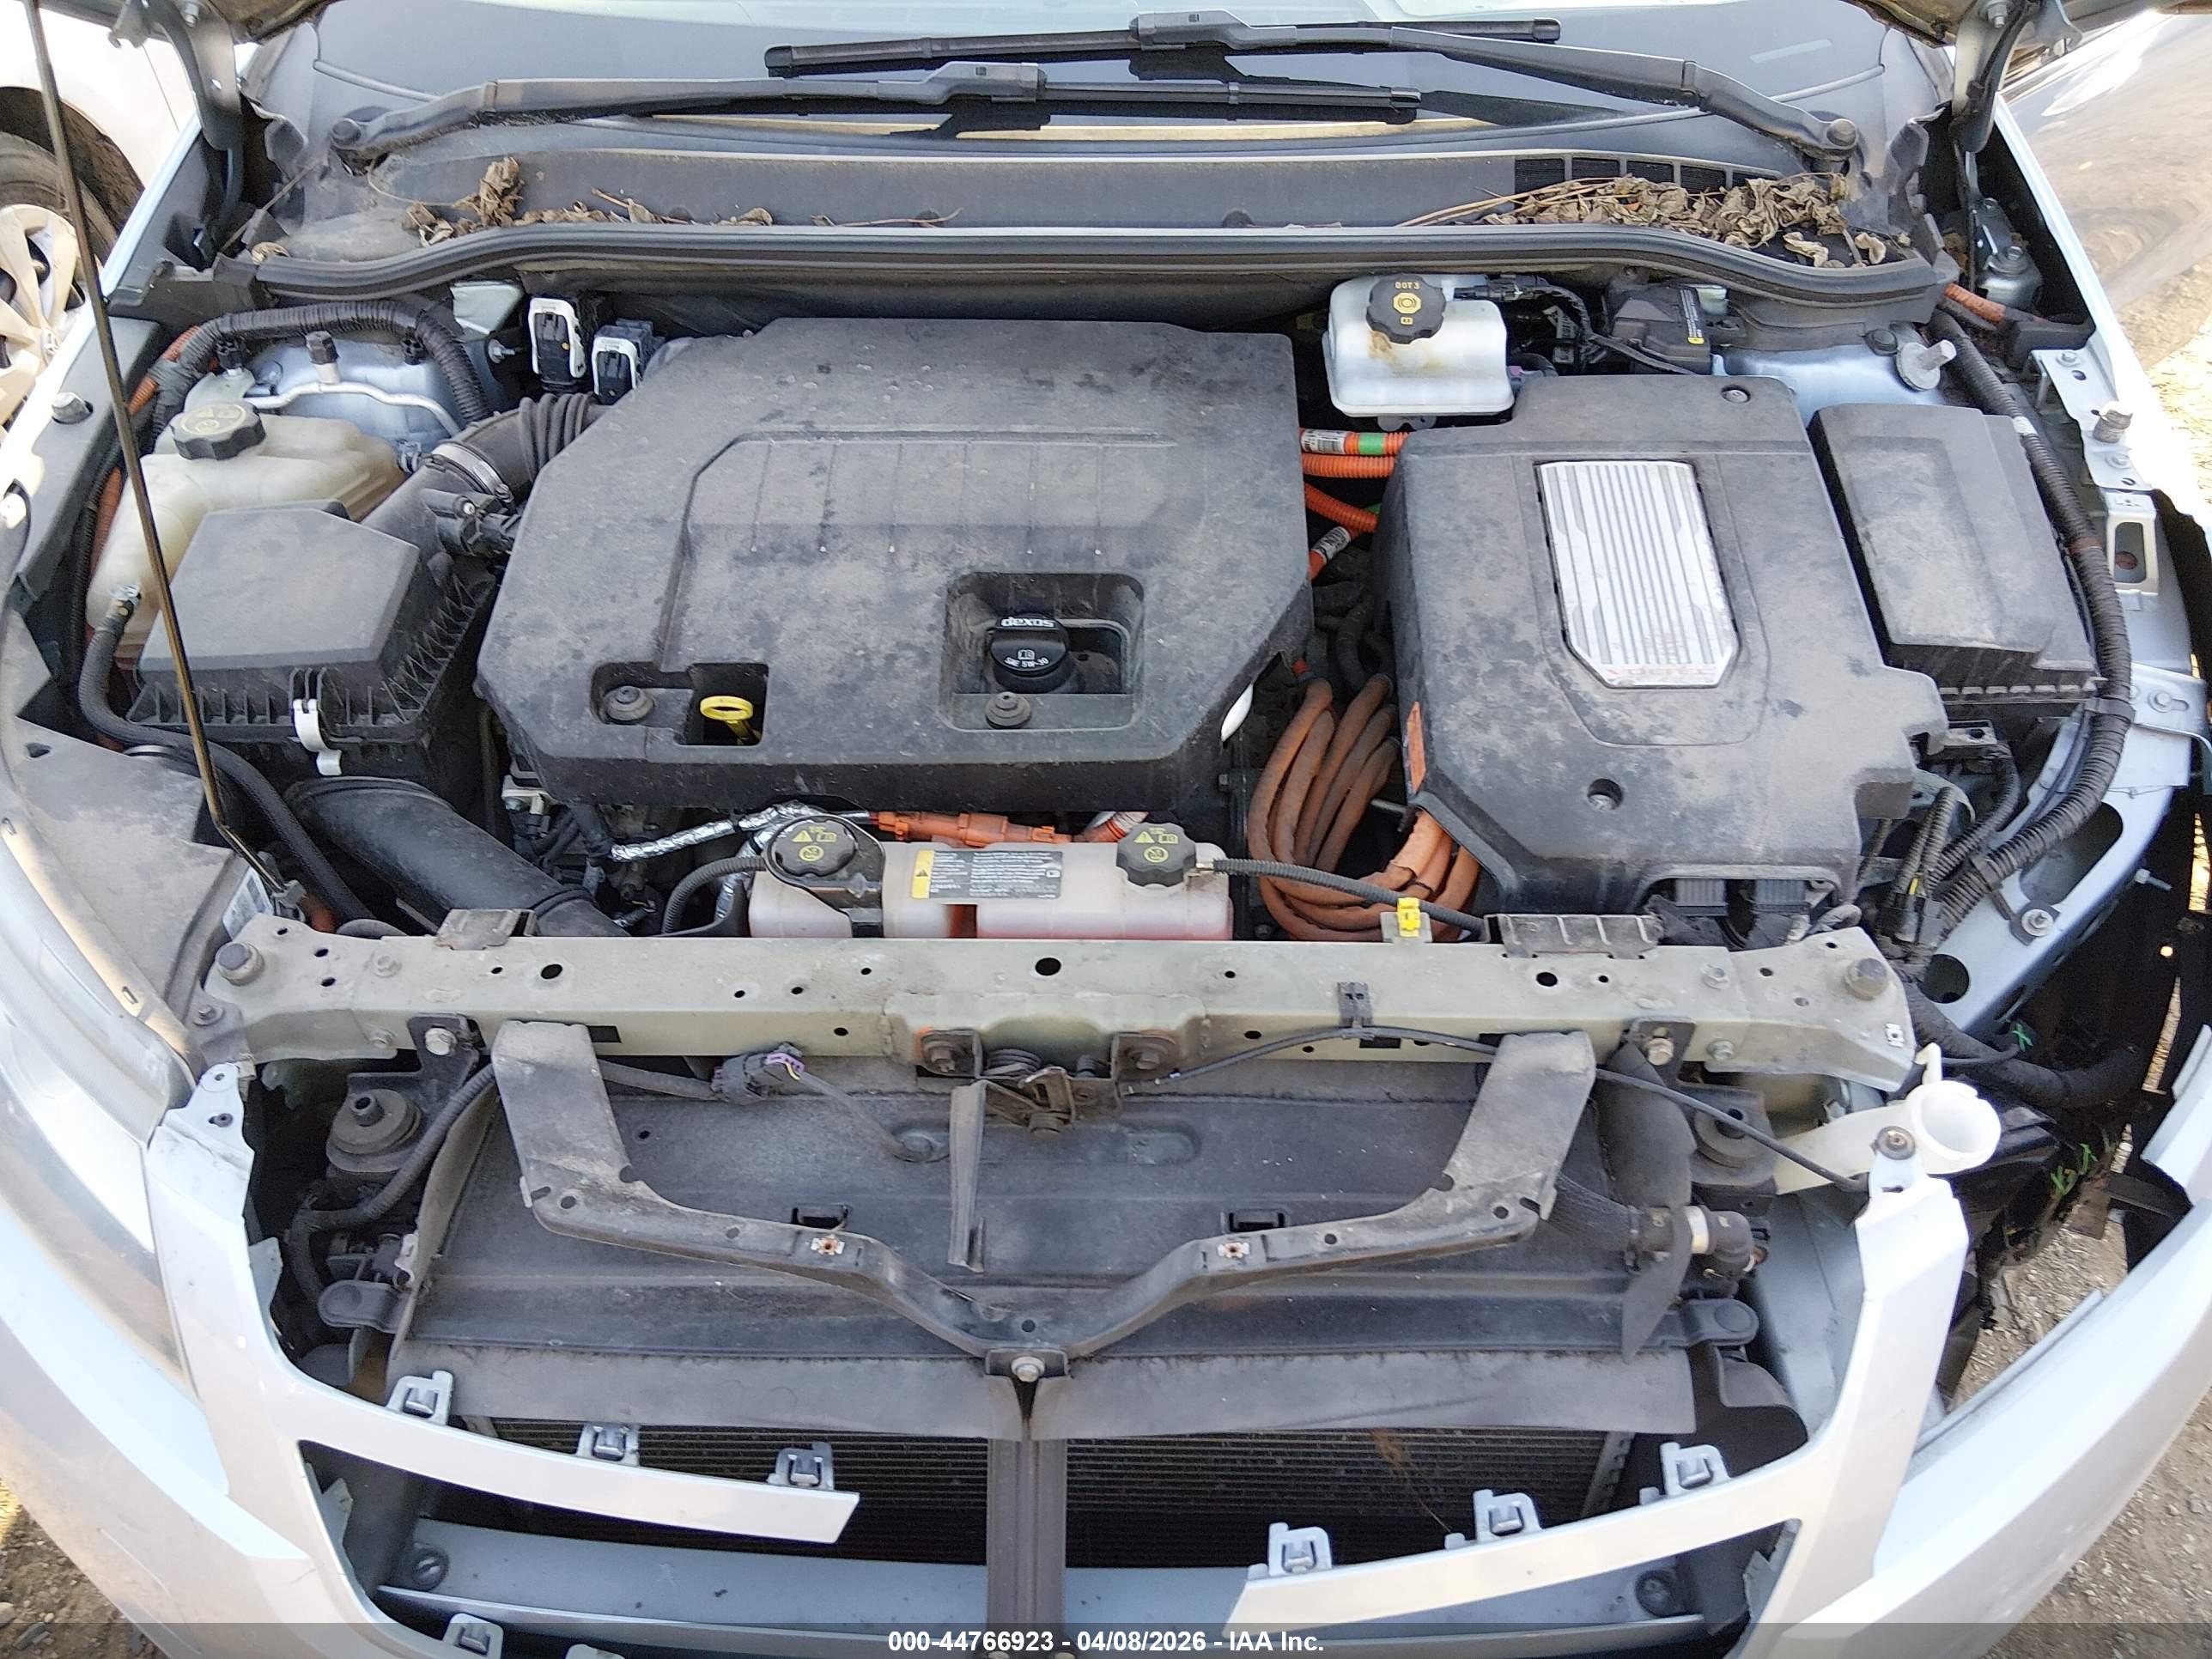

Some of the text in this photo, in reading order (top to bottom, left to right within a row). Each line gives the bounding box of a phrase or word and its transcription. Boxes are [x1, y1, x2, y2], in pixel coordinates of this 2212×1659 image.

[1000, 617, 1054, 628] dexos
[1004, 657, 1049, 668] SAE 5W-30
